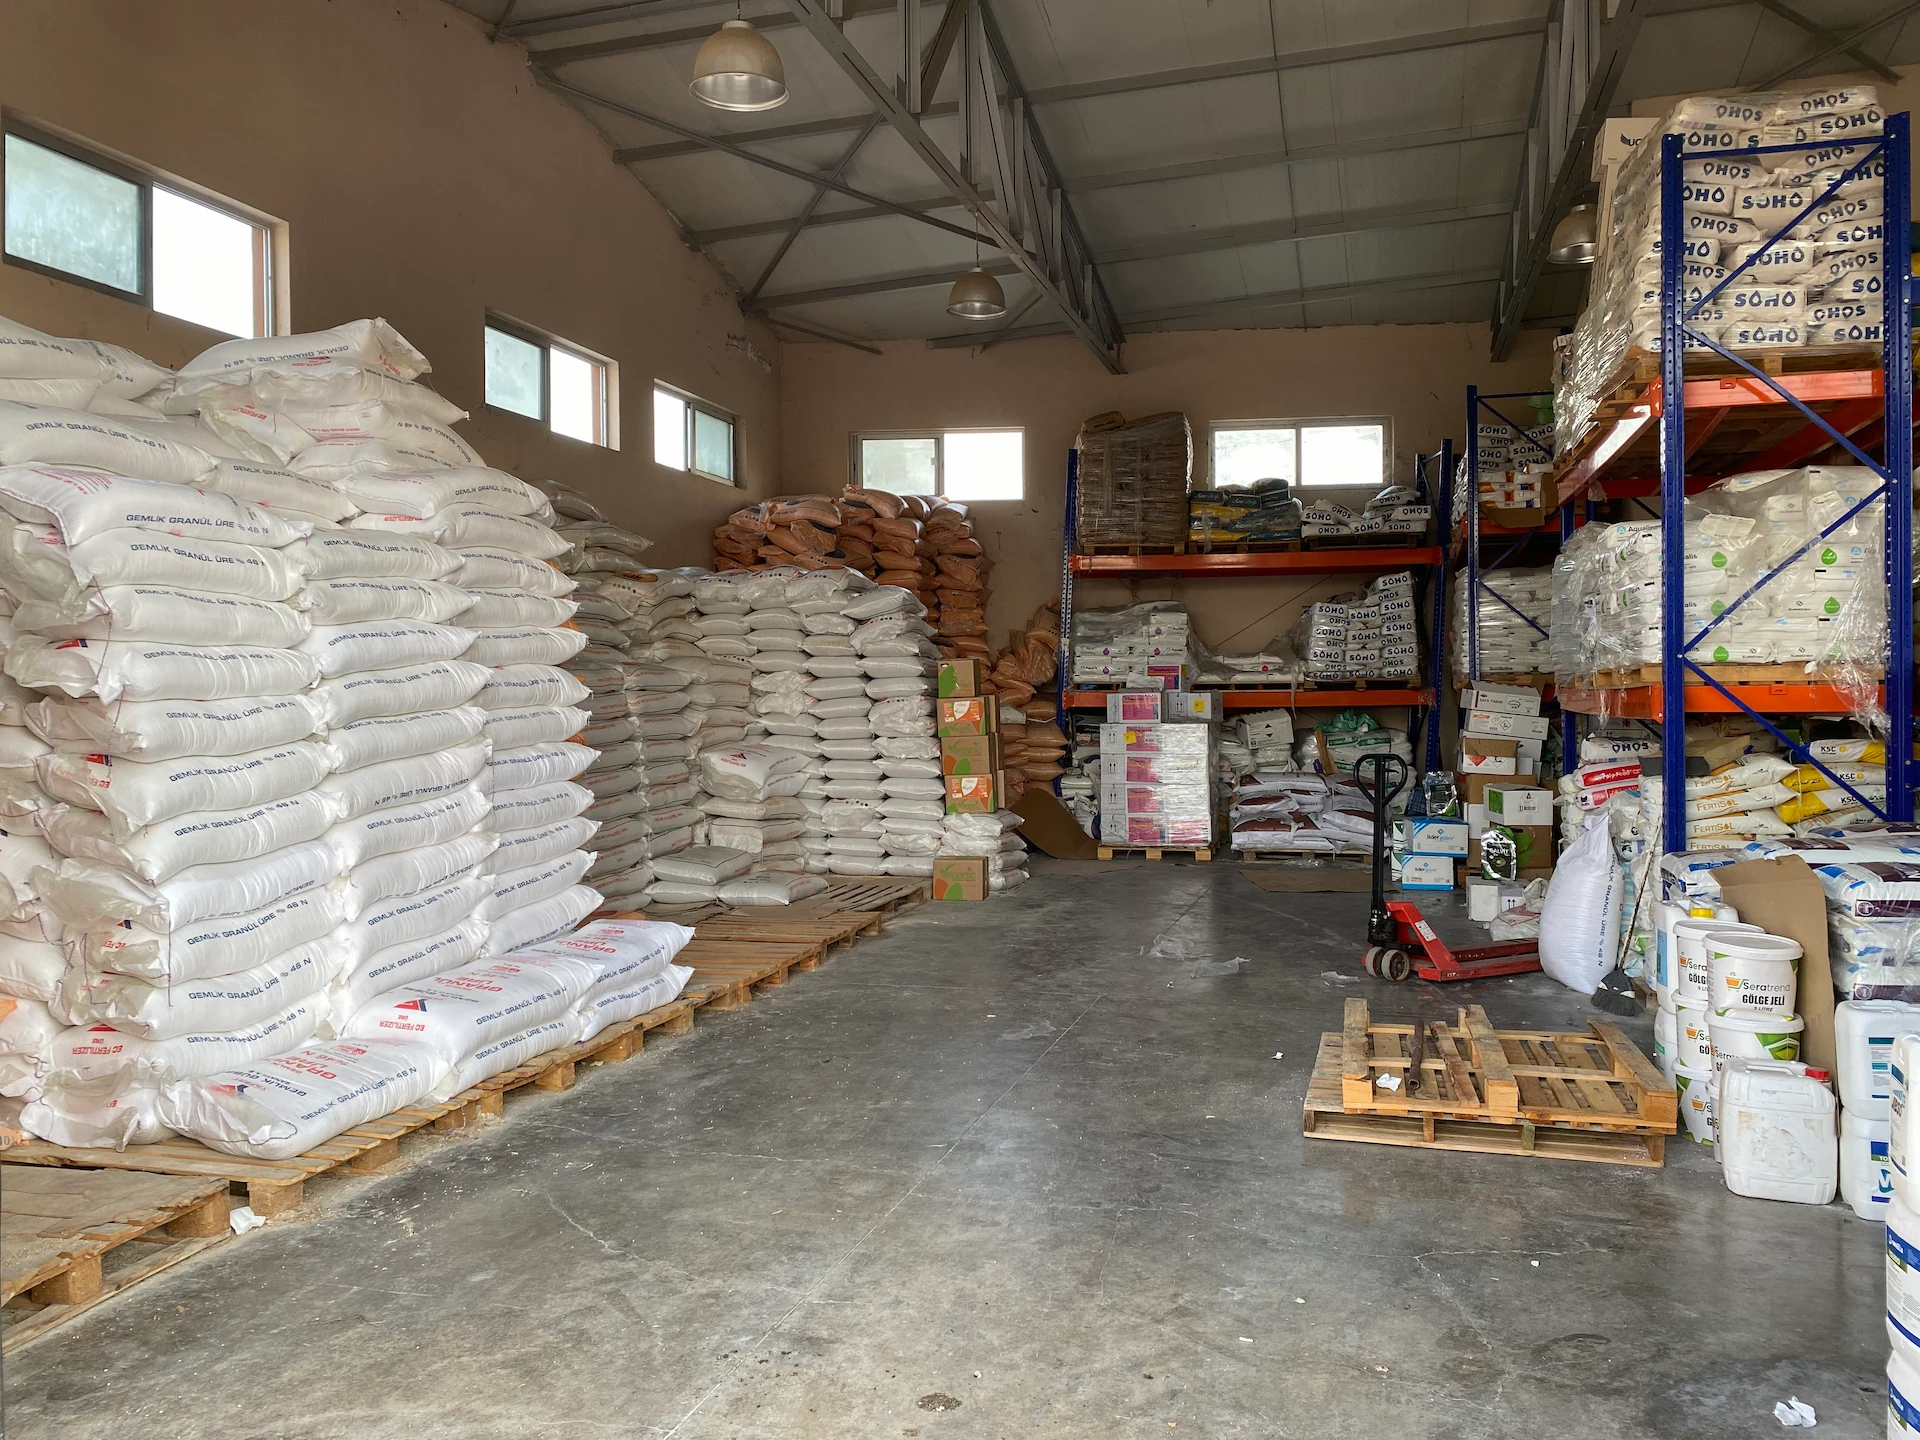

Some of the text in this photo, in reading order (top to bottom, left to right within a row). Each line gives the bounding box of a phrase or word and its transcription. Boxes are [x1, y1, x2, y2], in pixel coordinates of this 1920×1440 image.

[1821, 109, 1881, 134] SOHO
[1683, 187, 1724, 202] OHO
[1742, 192, 1803, 209] SOHO
[1837, 226, 1882, 243] SOH
[1852, 276, 1881, 293] SO
[1734, 290, 1795, 307] SOHO
[1738, 327, 1798, 343] SOHO
[1834, 325, 1883, 341] SOH
[1479, 426, 1507, 434] SOHO
[1480, 450, 1502, 458] OHO
[1305, 512, 1331, 521] SOHO
[216, 519, 234, 528] ÜRE
[1354, 522, 1380, 532] SOHO
[1382, 575, 1409, 586] SOHO
[1319, 605, 1344, 614] SOHO
[1384, 600, 1410, 611] SOHO
[1351, 611, 1376, 619] SOHO
[1386, 623, 1412, 631] SOHO
[1352, 632, 1378, 640] SOHO
[1388, 646, 1414, 655] SOHO
[1349, 653, 1375, 661] SOHO
[1386, 669, 1413, 677] SOHO
[1610, 740, 1651, 753] SOHO
[244, 760, 263, 769] ÜRE
[1839, 772, 1856, 780] KSC
[247, 810, 265, 820] ÜRE
[258, 913, 276, 925] ÜRE
[426, 944, 440, 953] ÜRE
[265, 977, 279, 989] ÜRE
[1688, 972, 1707, 985] GÖLG
[532, 994, 546, 1002] ÜRE
[1743, 994, 1785, 1005] GÖLGE JELİ
[379, 1020, 414, 1030] FERTILIZER
[526, 1028, 541, 1037] ÜRE
[371, 1080, 386, 1089] ÜRE
